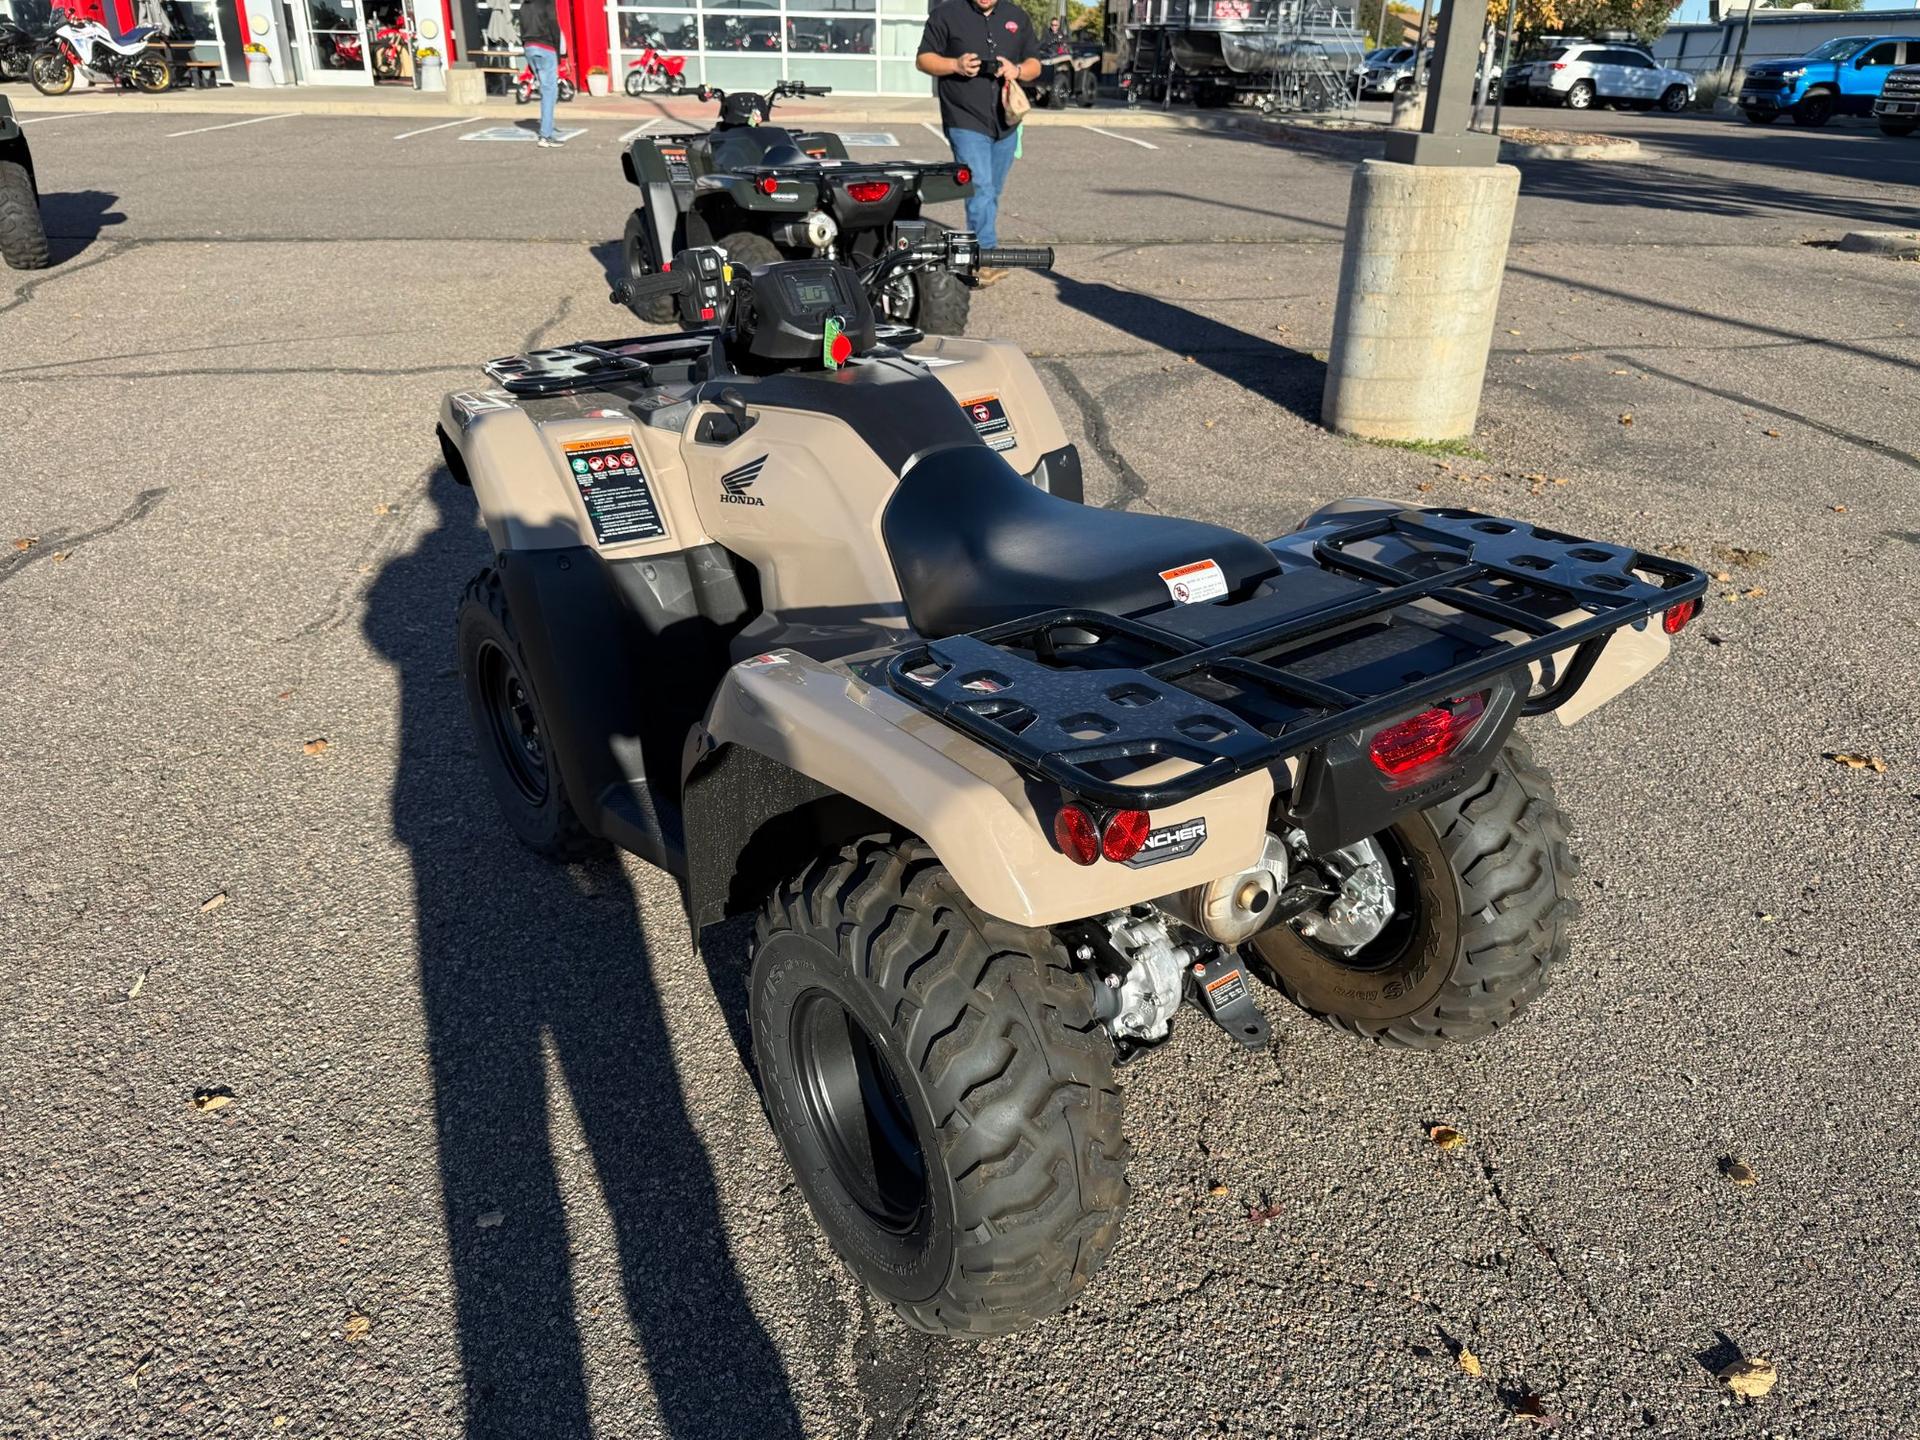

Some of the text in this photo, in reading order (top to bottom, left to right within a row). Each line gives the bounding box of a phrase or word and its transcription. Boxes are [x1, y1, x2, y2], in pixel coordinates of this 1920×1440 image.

[585, 440, 614, 448] WARNING
[720, 494, 765, 506] HONDA
[1180, 564, 1205, 575] WARNING
[1139, 824, 1206, 851] NCHER
